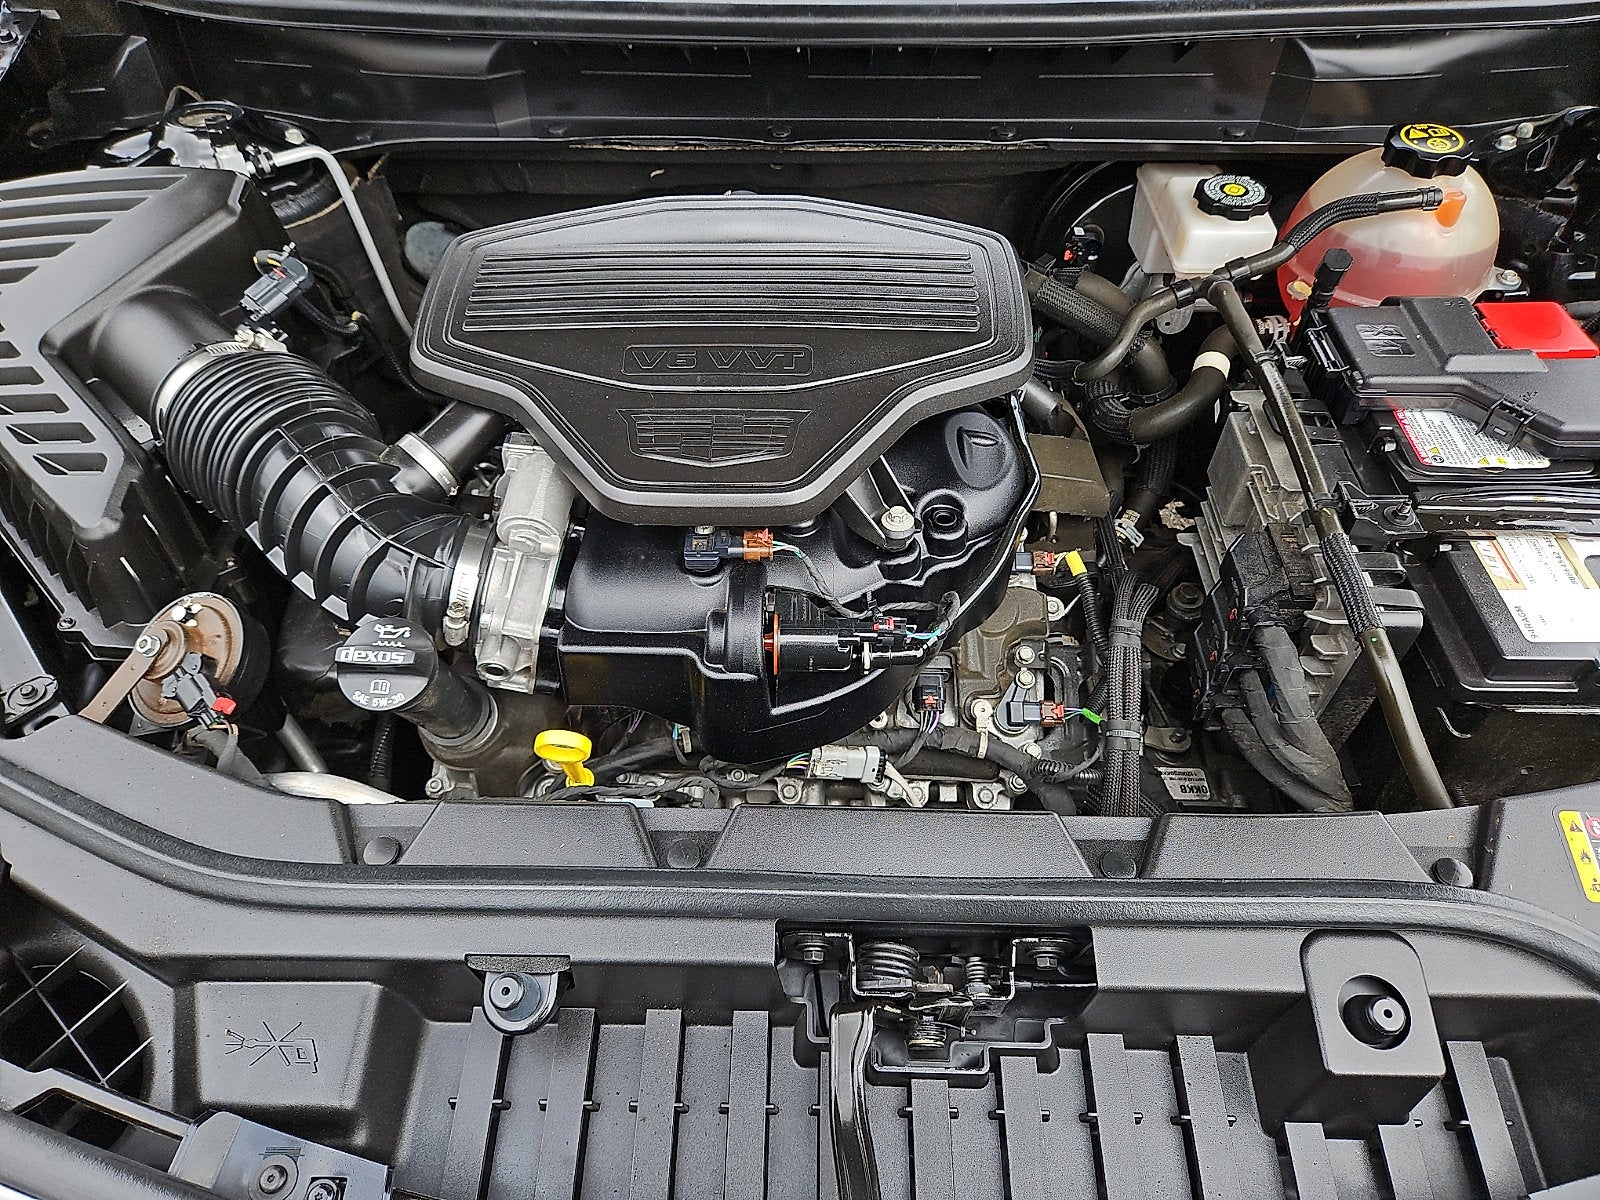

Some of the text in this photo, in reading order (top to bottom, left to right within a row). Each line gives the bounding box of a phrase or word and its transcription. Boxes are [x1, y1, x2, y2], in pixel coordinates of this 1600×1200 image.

[631, 350, 805, 370] V6 VVT
[340, 646, 408, 663] dexos
[352, 690, 405, 708] SAE 5W-30
